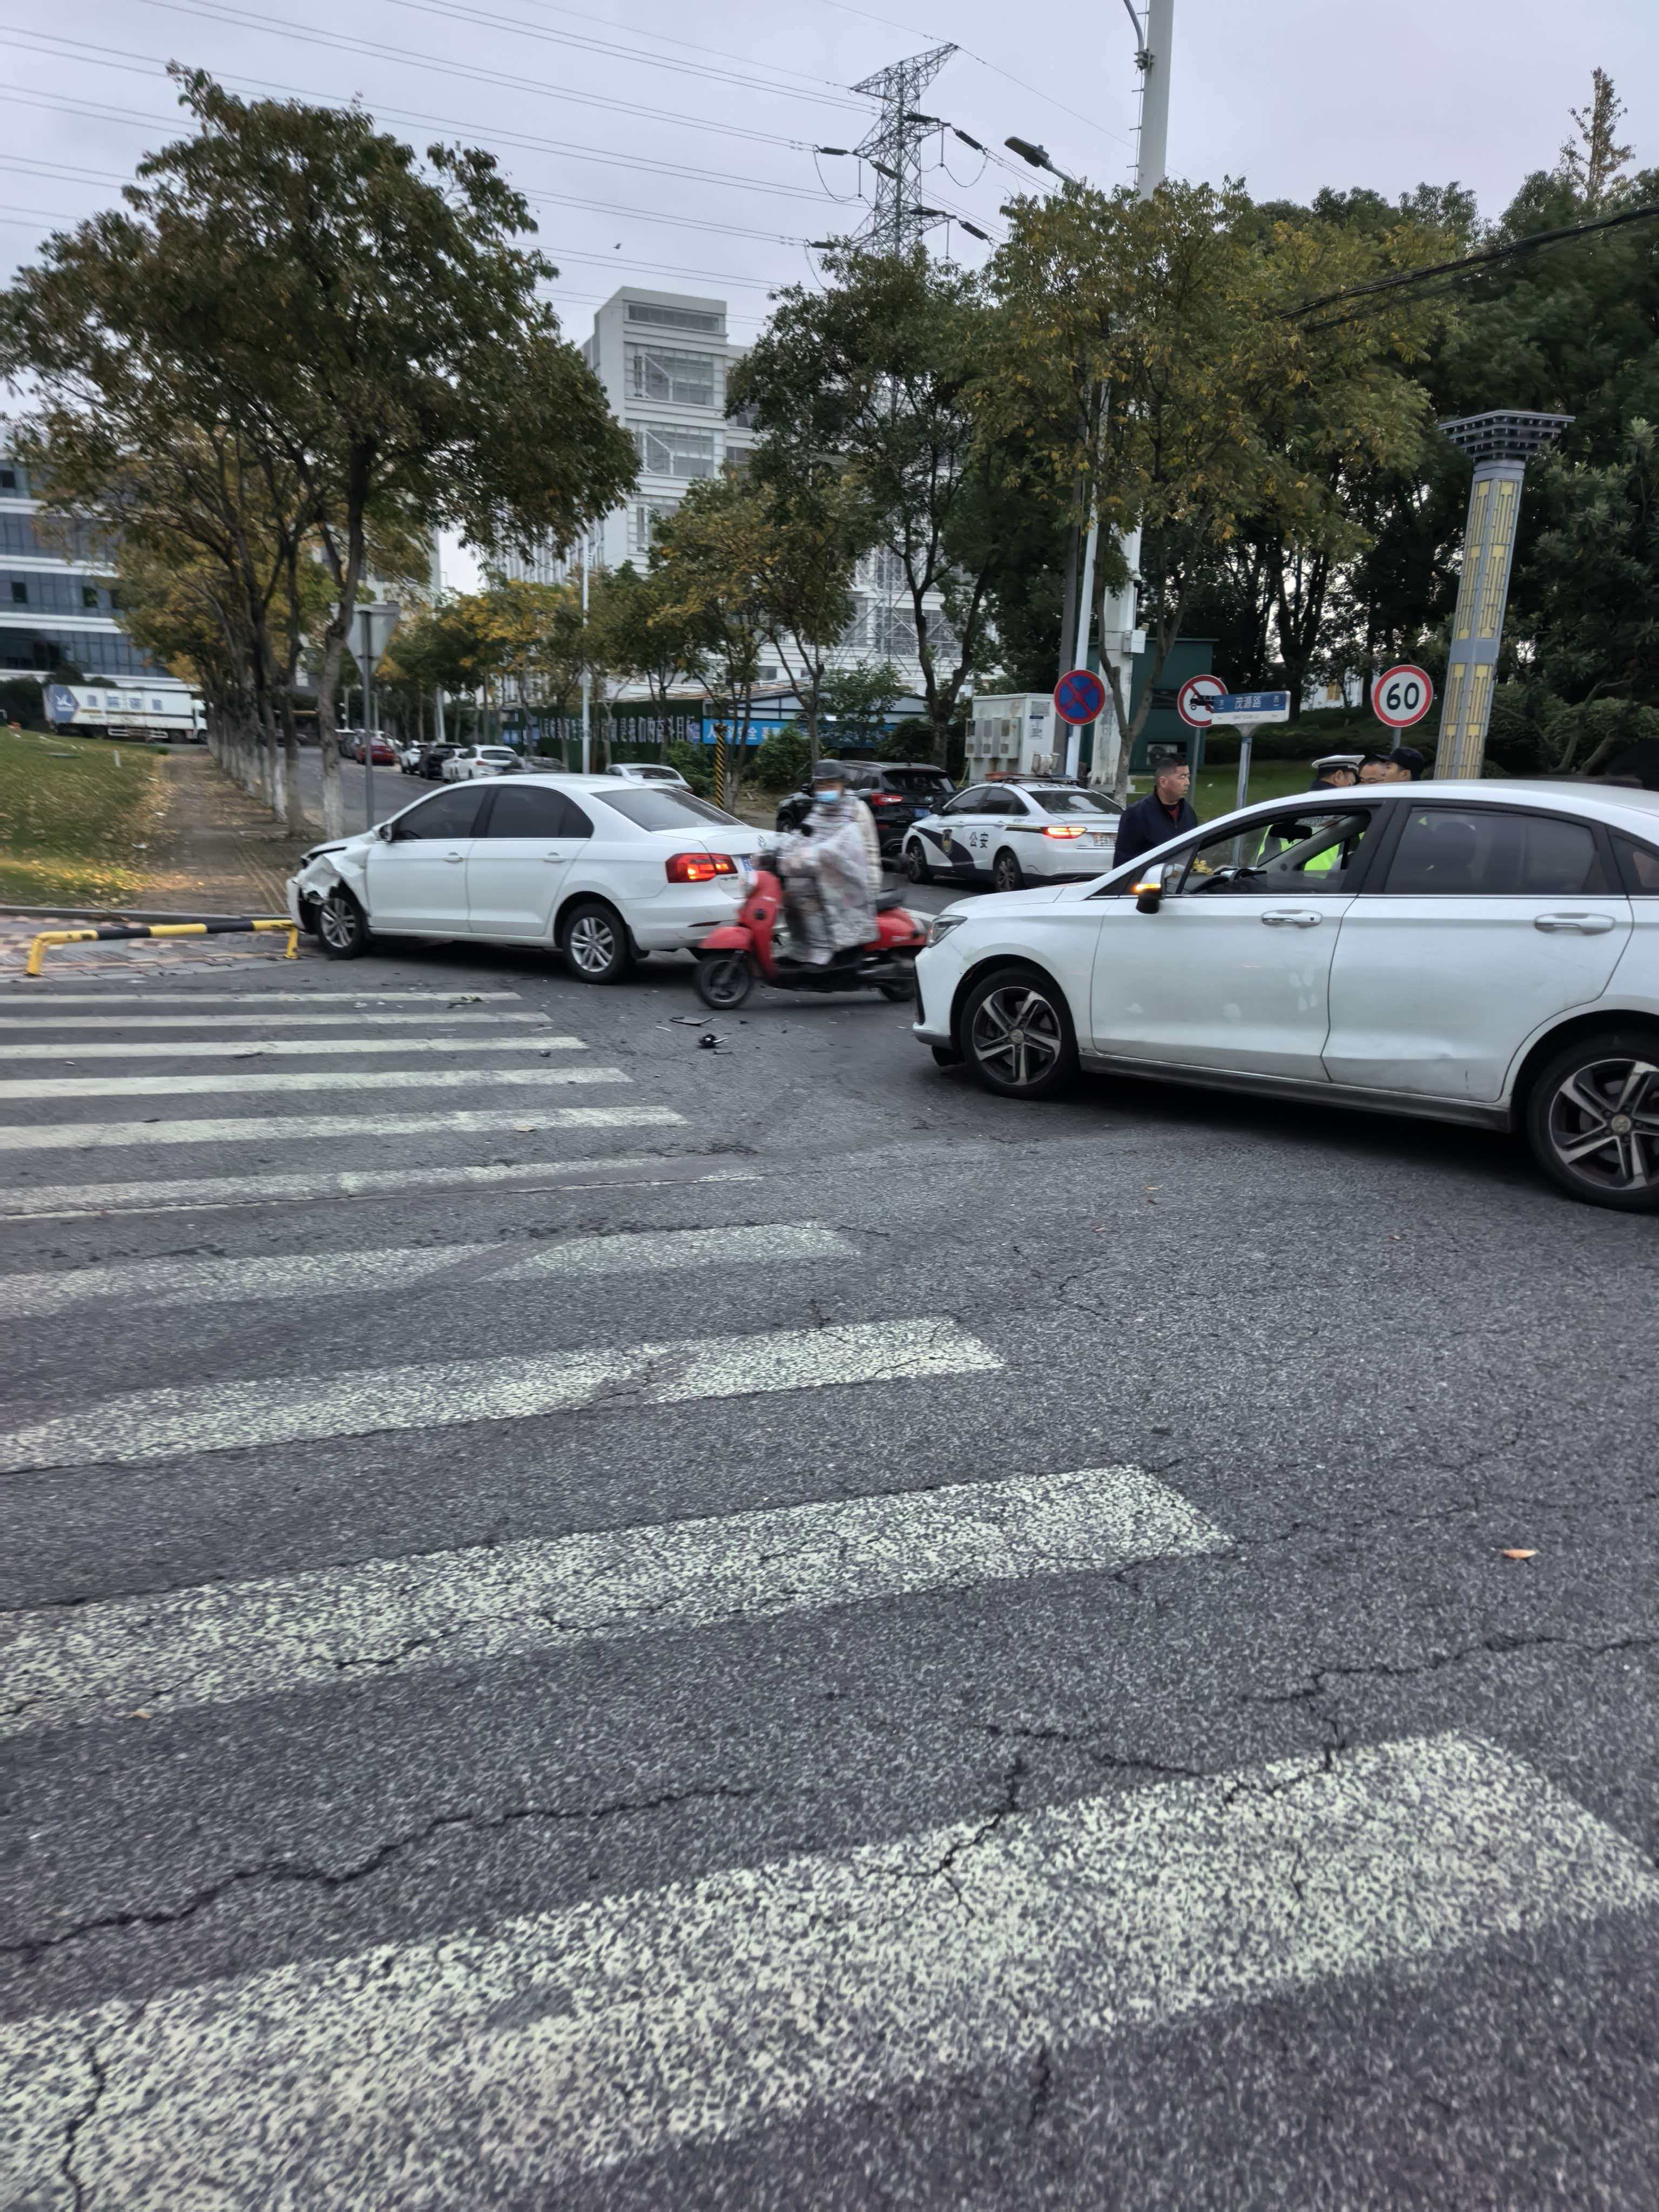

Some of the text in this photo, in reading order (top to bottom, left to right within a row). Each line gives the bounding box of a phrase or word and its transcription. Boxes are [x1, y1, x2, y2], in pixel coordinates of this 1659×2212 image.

[1235, 696, 1262, 709] 茂源路
[1386, 682, 1419, 710] 60
[969, 832, 989, 849] 公安
